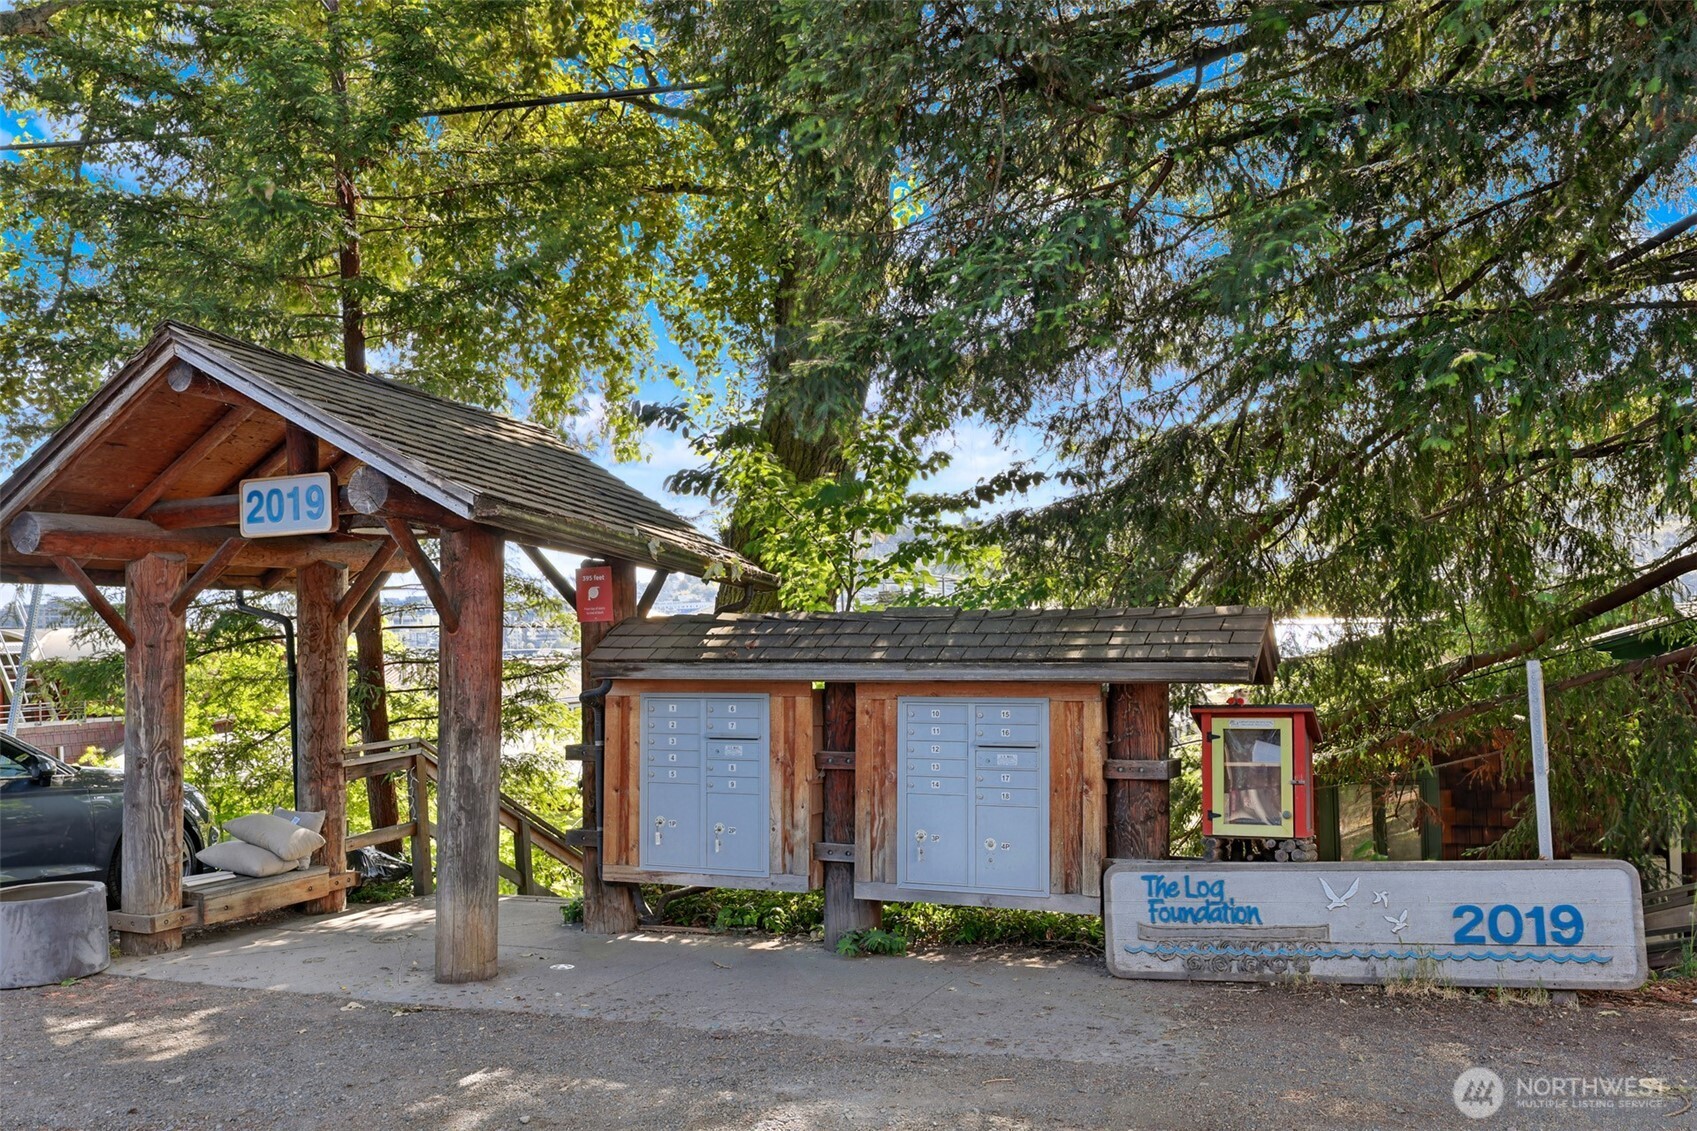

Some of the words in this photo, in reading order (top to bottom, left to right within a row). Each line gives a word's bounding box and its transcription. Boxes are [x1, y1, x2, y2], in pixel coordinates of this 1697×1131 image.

[246, 484, 325, 524] 2019
[1141, 875, 1180, 898] The
[1184, 875, 1225, 905] Log
[1147, 898, 1263, 925] Foundation
[1452, 904, 1584, 946] 2019
